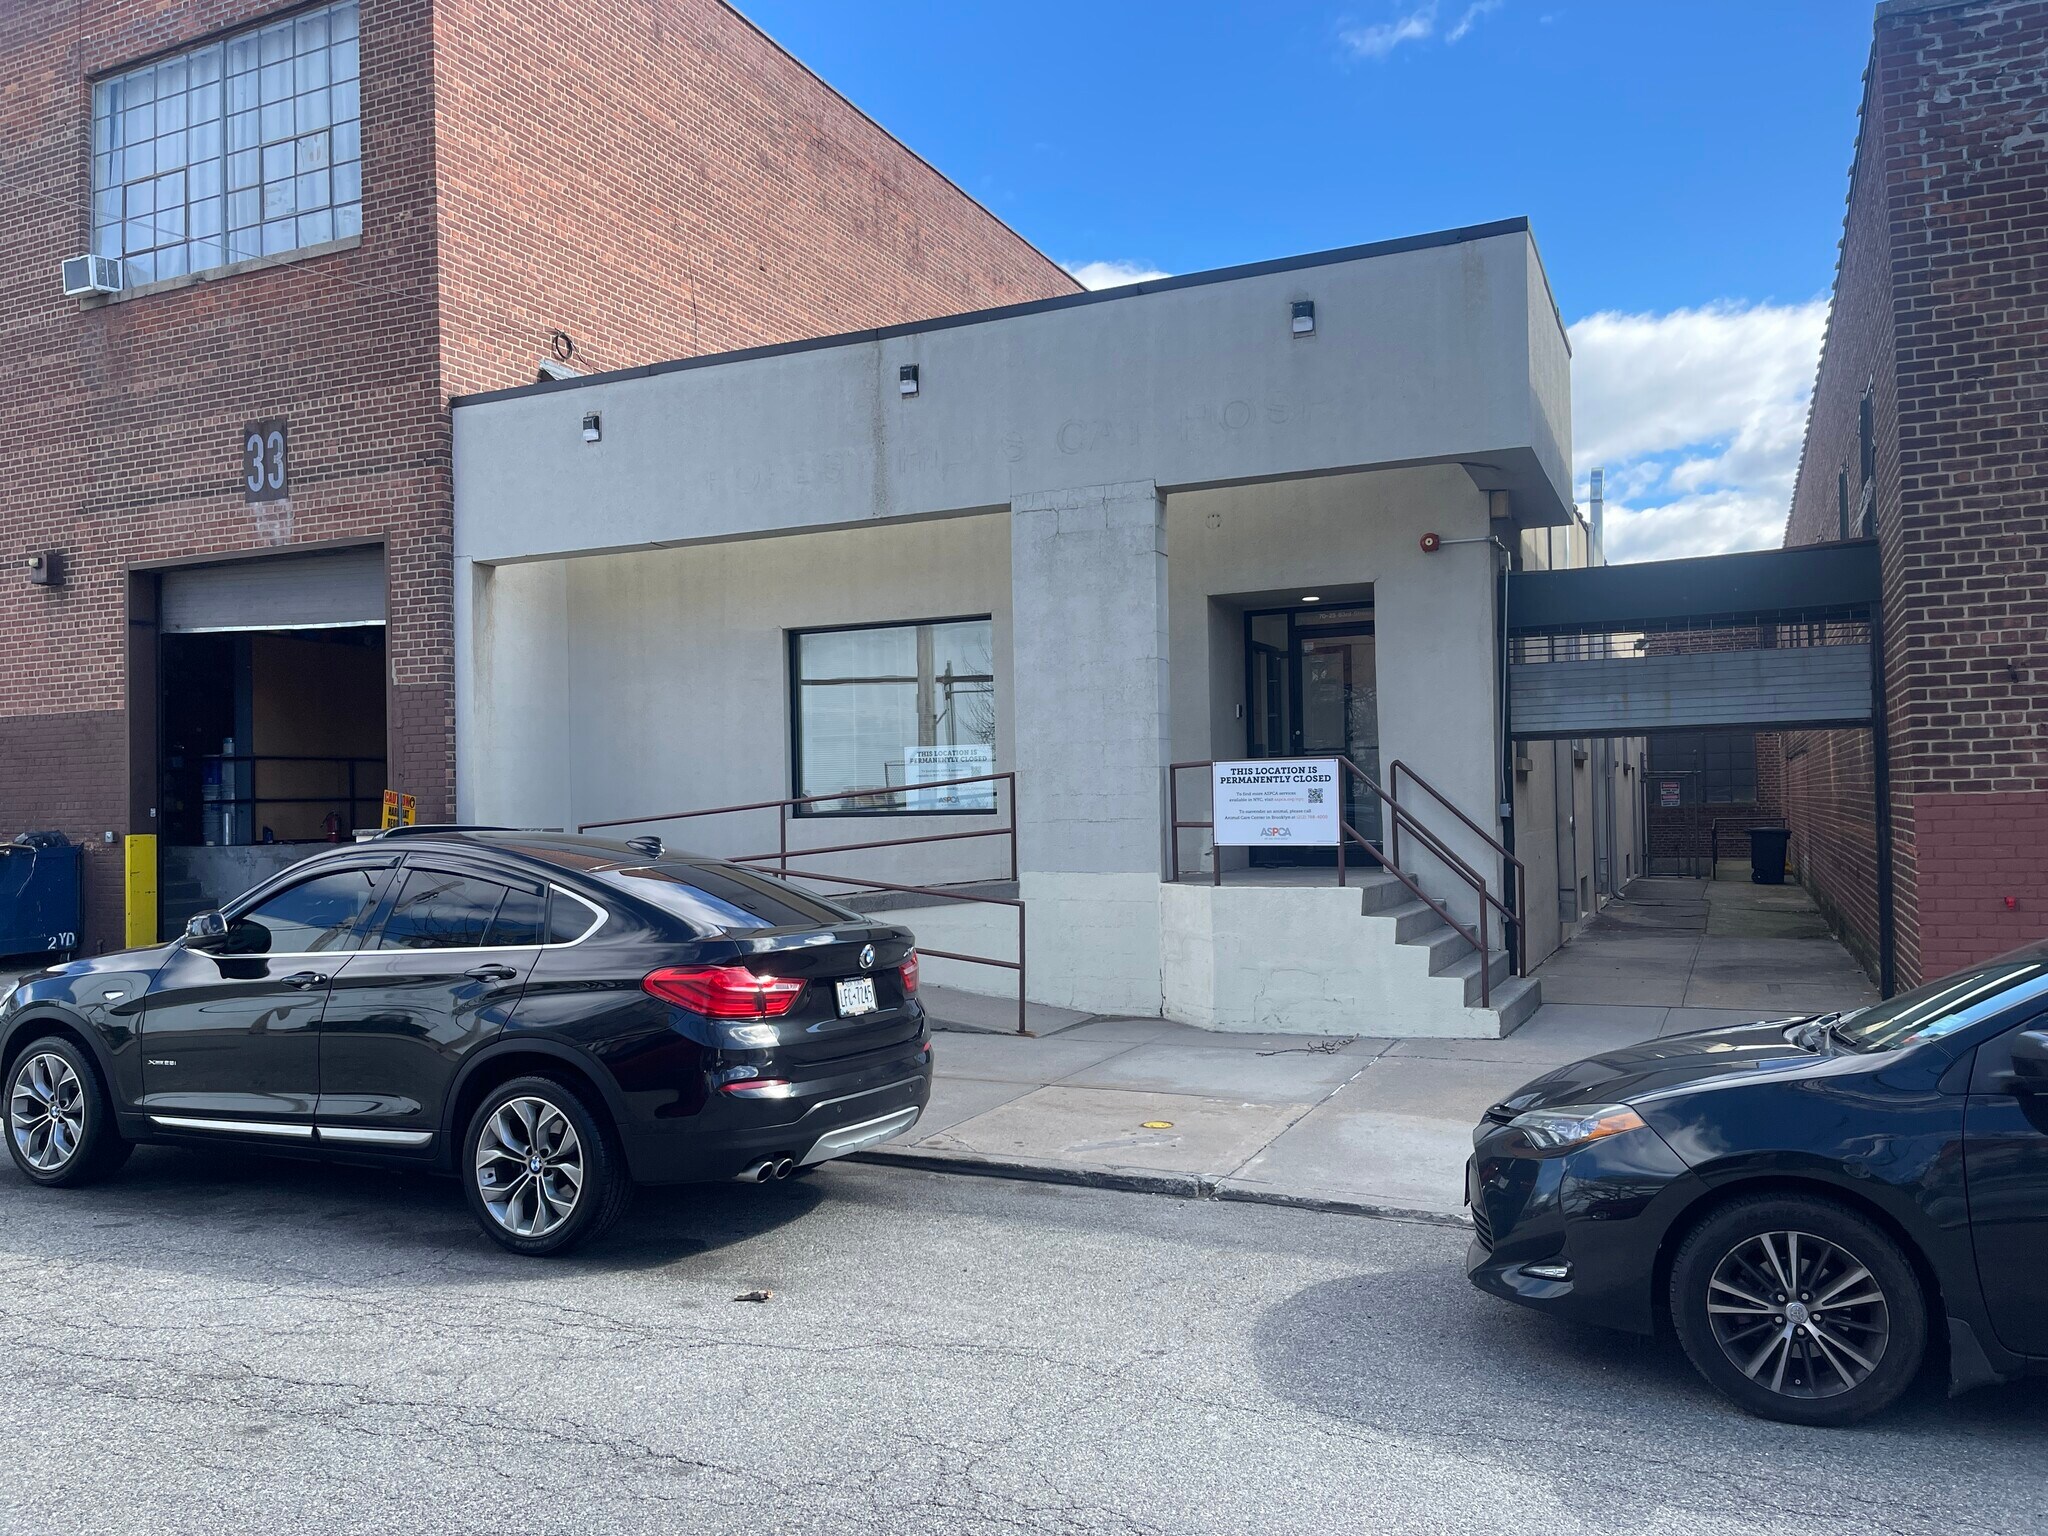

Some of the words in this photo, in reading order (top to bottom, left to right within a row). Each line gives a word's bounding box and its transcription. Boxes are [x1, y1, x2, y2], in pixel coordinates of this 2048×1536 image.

[247, 431, 284, 492] 33
[1255, 766, 1305, 775] LOCATION
[1308, 766, 1318, 774] IS
[1220, 775, 1291, 784] PERMANENTLY
[1292, 775, 1332, 783] CLOSED
[1260, 827, 1292, 836] ASPCA
[48, 936, 57, 950] 2
[59, 932, 75, 946] YD
